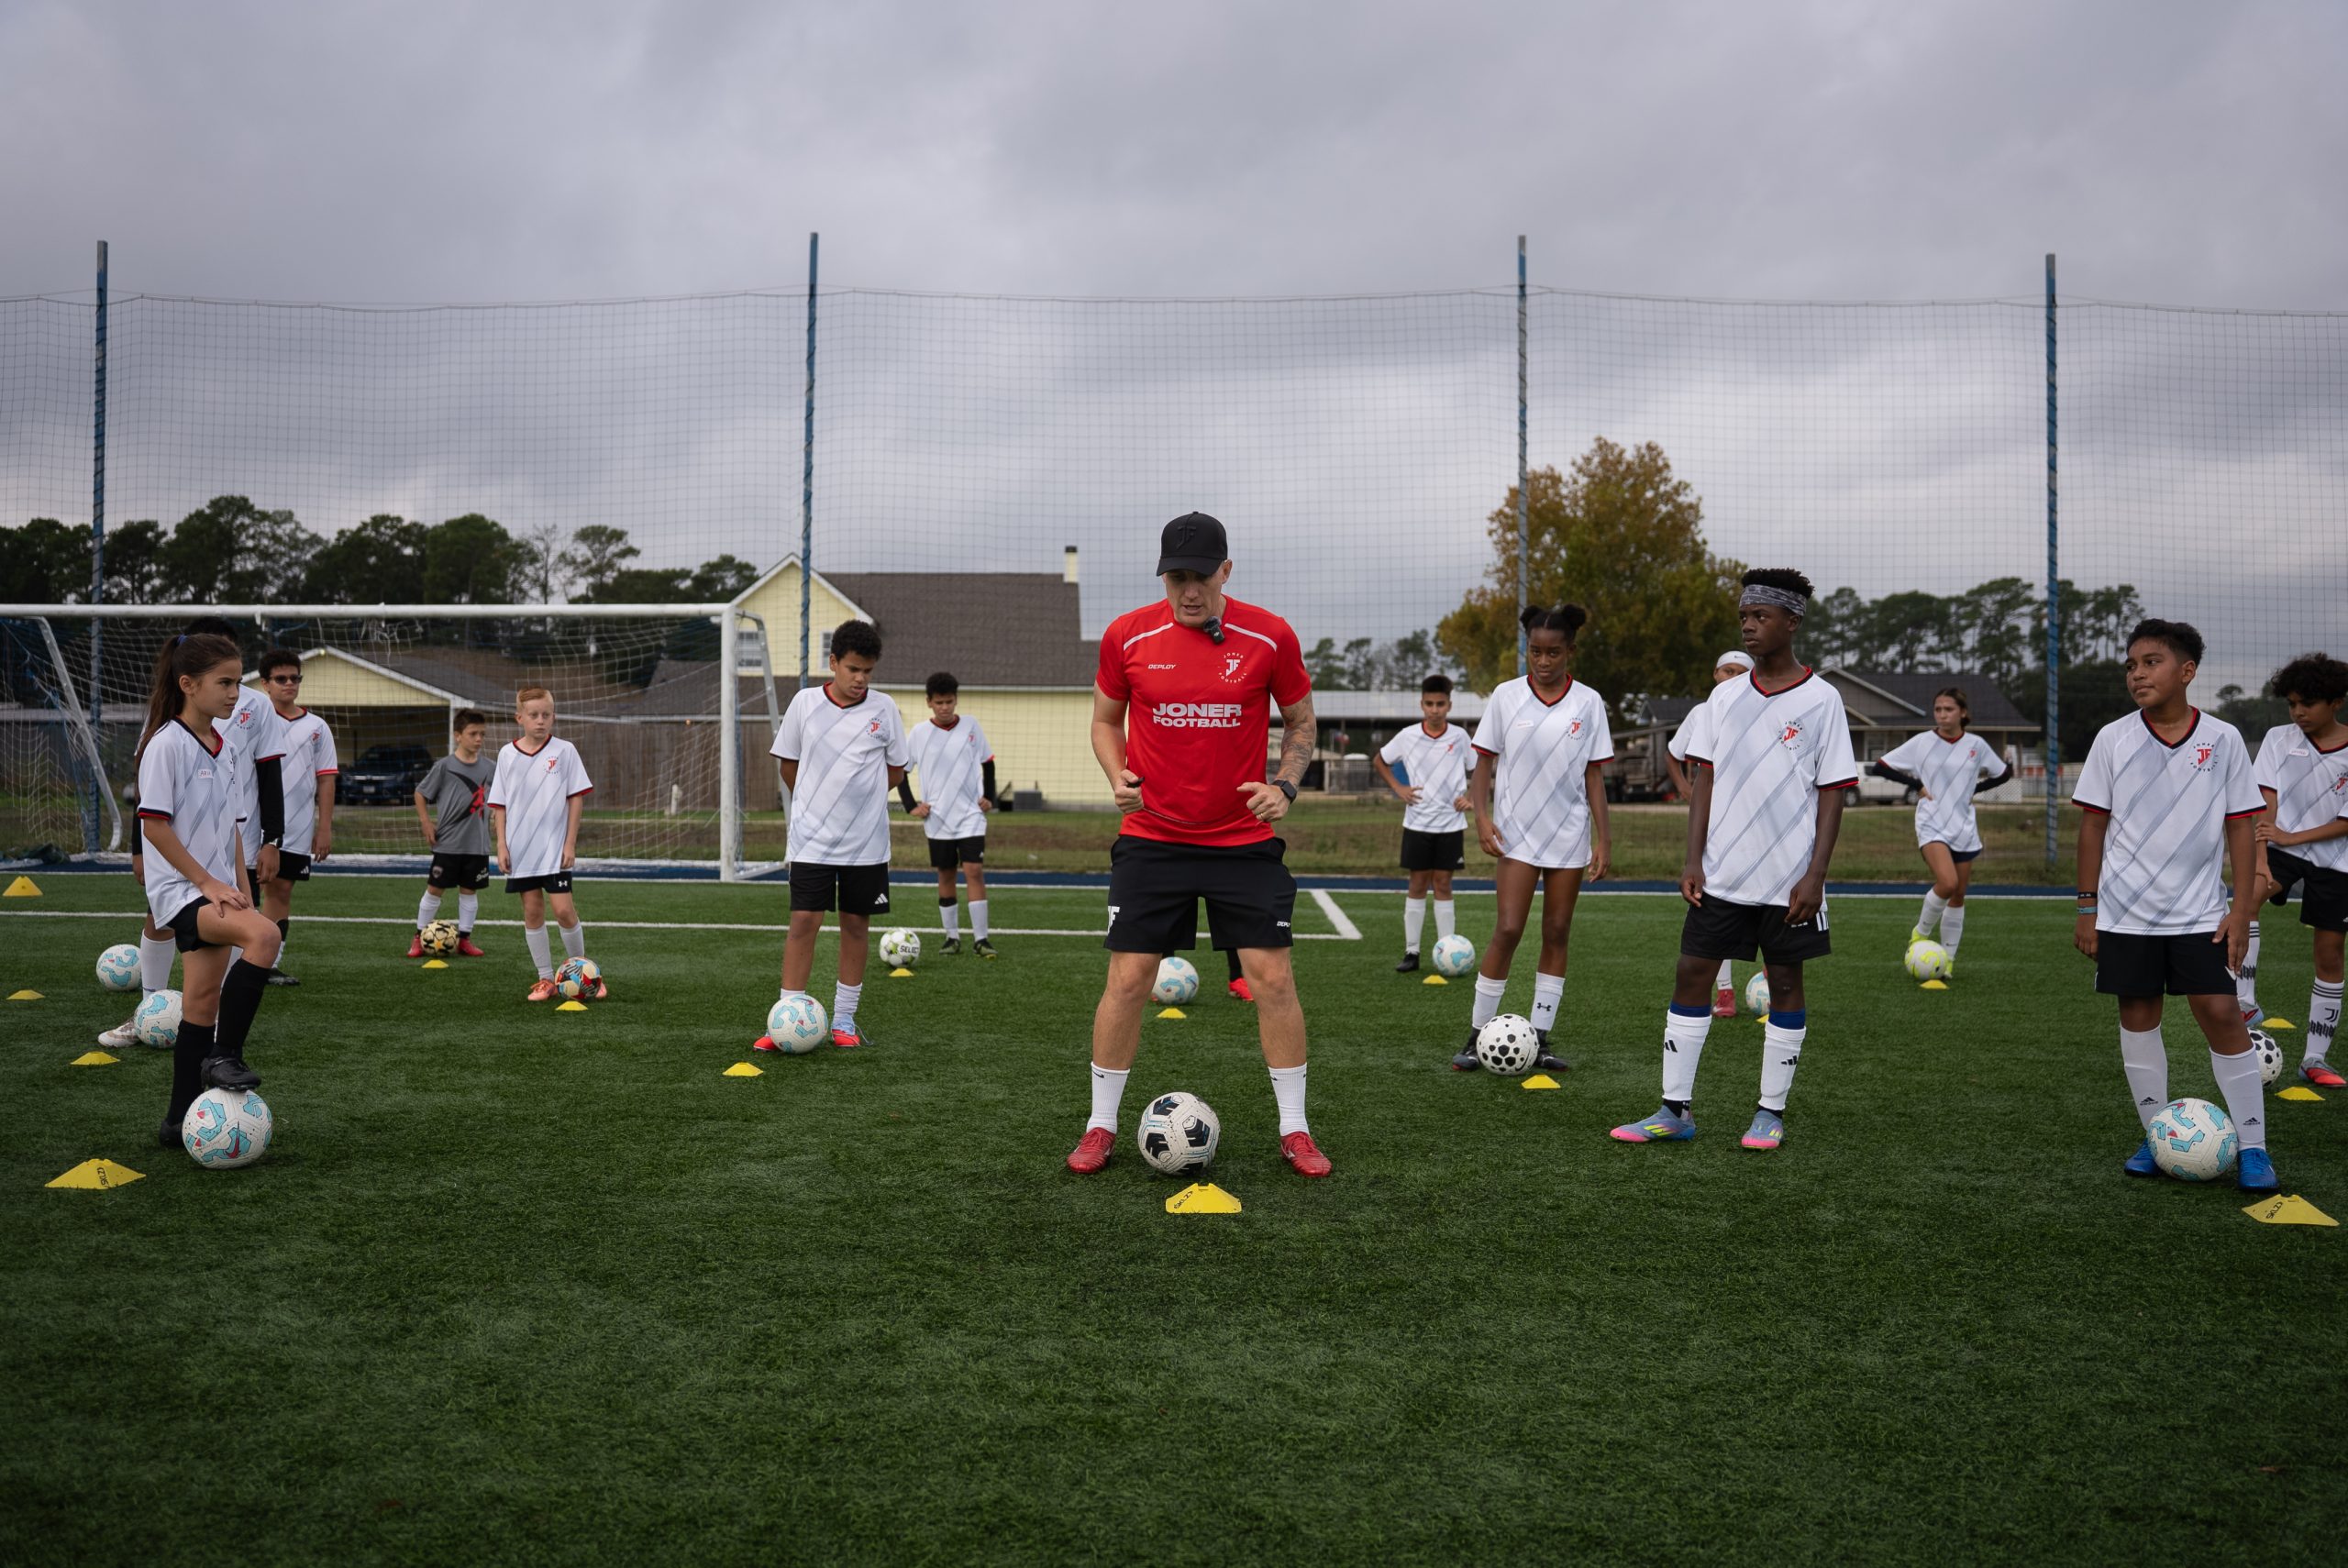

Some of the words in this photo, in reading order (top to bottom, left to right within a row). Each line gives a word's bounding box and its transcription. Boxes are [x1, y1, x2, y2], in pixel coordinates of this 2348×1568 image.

[1225, 658, 1241, 677] JF
[1218, 672, 1247, 683] FOOTBALL
[1152, 702, 1242, 718] JONER
[240, 712, 250, 724] JF
[1153, 715, 1241, 728] FOOTBALL
[870, 722, 880, 733] JF
[1571, 722, 1581, 734] JF
[1783, 725, 1799, 742] JF
[2196, 748, 2212, 766] JF
